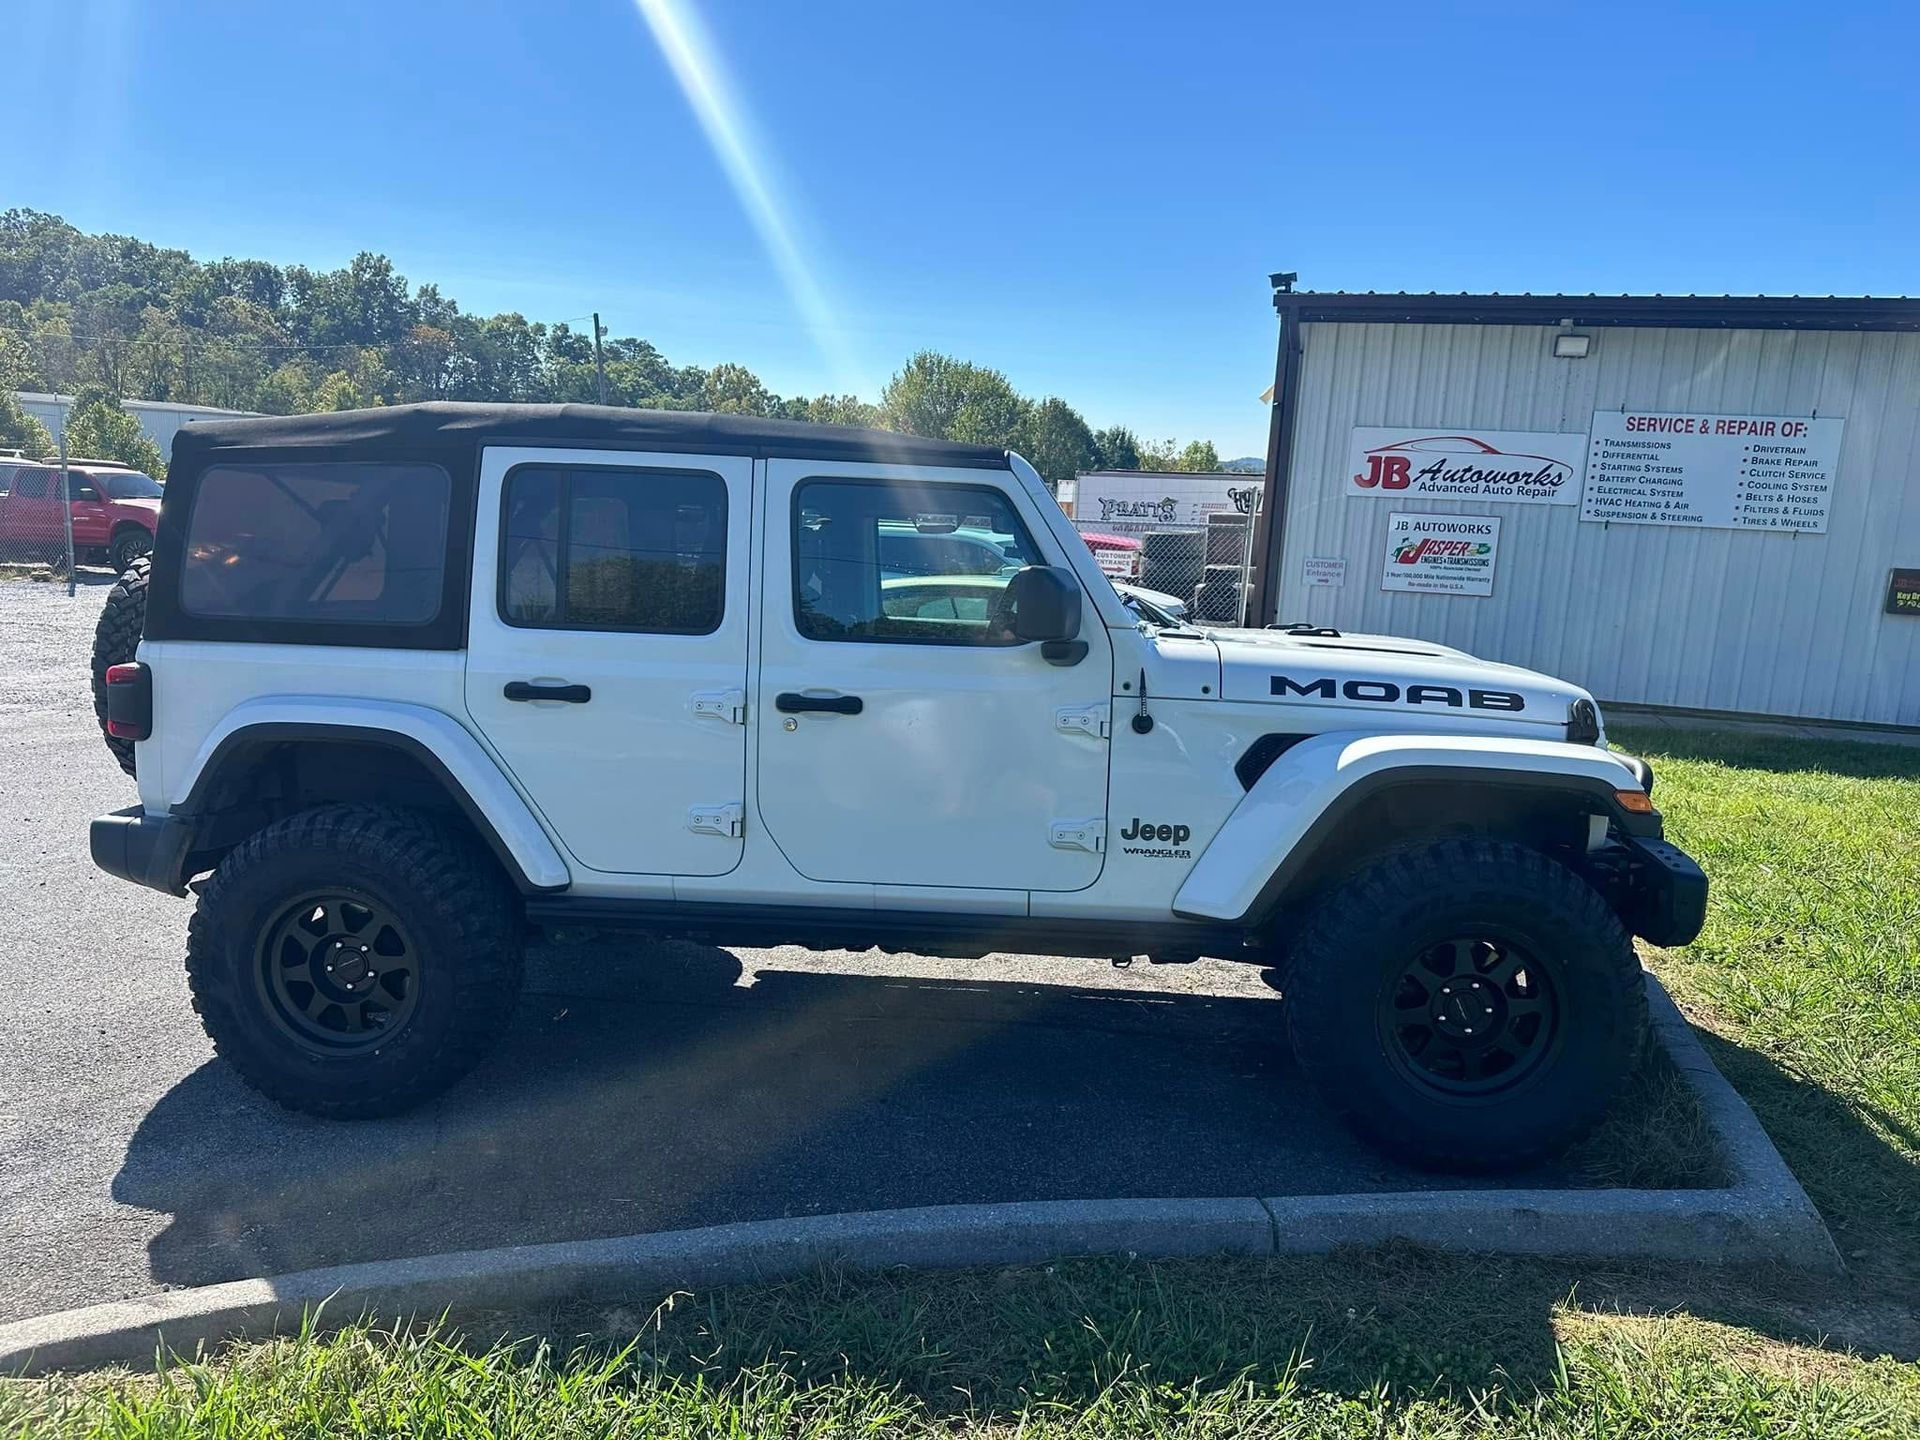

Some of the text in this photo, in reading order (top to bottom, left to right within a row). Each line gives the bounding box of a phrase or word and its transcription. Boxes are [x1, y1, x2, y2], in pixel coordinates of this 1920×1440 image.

[1626, 416, 1808, 438] SERVICE & REPAIR OF:
[1604, 439, 1672, 449] TRANSMISSIONS
[1753, 444, 1806, 454] DRIVETRAIN
[1602, 450, 1660, 461] DIFFERENTIAL
[1751, 456, 1818, 467] BRAKE REPAIR
[1353, 456, 1566, 490] JB Autoworks
[1600, 462, 1683, 474] STARTING SYSTEMS
[1749, 468, 1826, 480] CLUTCH SERVICE
[1599, 474, 1683, 486] BATTERY CHARGING
[1747, 480, 1827, 492] COOLING SYSTEM
[1418, 481, 1557, 499] Advanced Auto Repair
[1597, 485, 1684, 497] ELECTRICAL SYSTEM
[1595, 497, 1690, 510] HVAC HEATING & AIR
[1745, 492, 1818, 504] BELTS & HOSES
[1593, 509, 1703, 522] SUSPENSION & STEERING
[1743, 504, 1825, 516] FILTERS & FLUIDS
[1395, 521, 1492, 535] JB AUTOWORKS
[1742, 516, 1818, 528] TIRES & WHEELS
[1398, 538, 1472, 564] JASPER
[1305, 560, 1344, 569] CUSTOMER
[1421, 556, 1443, 564] ENGINES
[1447, 557, 1490, 567] TRANSMISSIONS
[1306, 569, 1341, 577] Entrance
[1270, 675, 1526, 712] MOAB
[1120, 818, 1191, 846] Jeep
[1123, 847, 1191, 856] WRANGLER
